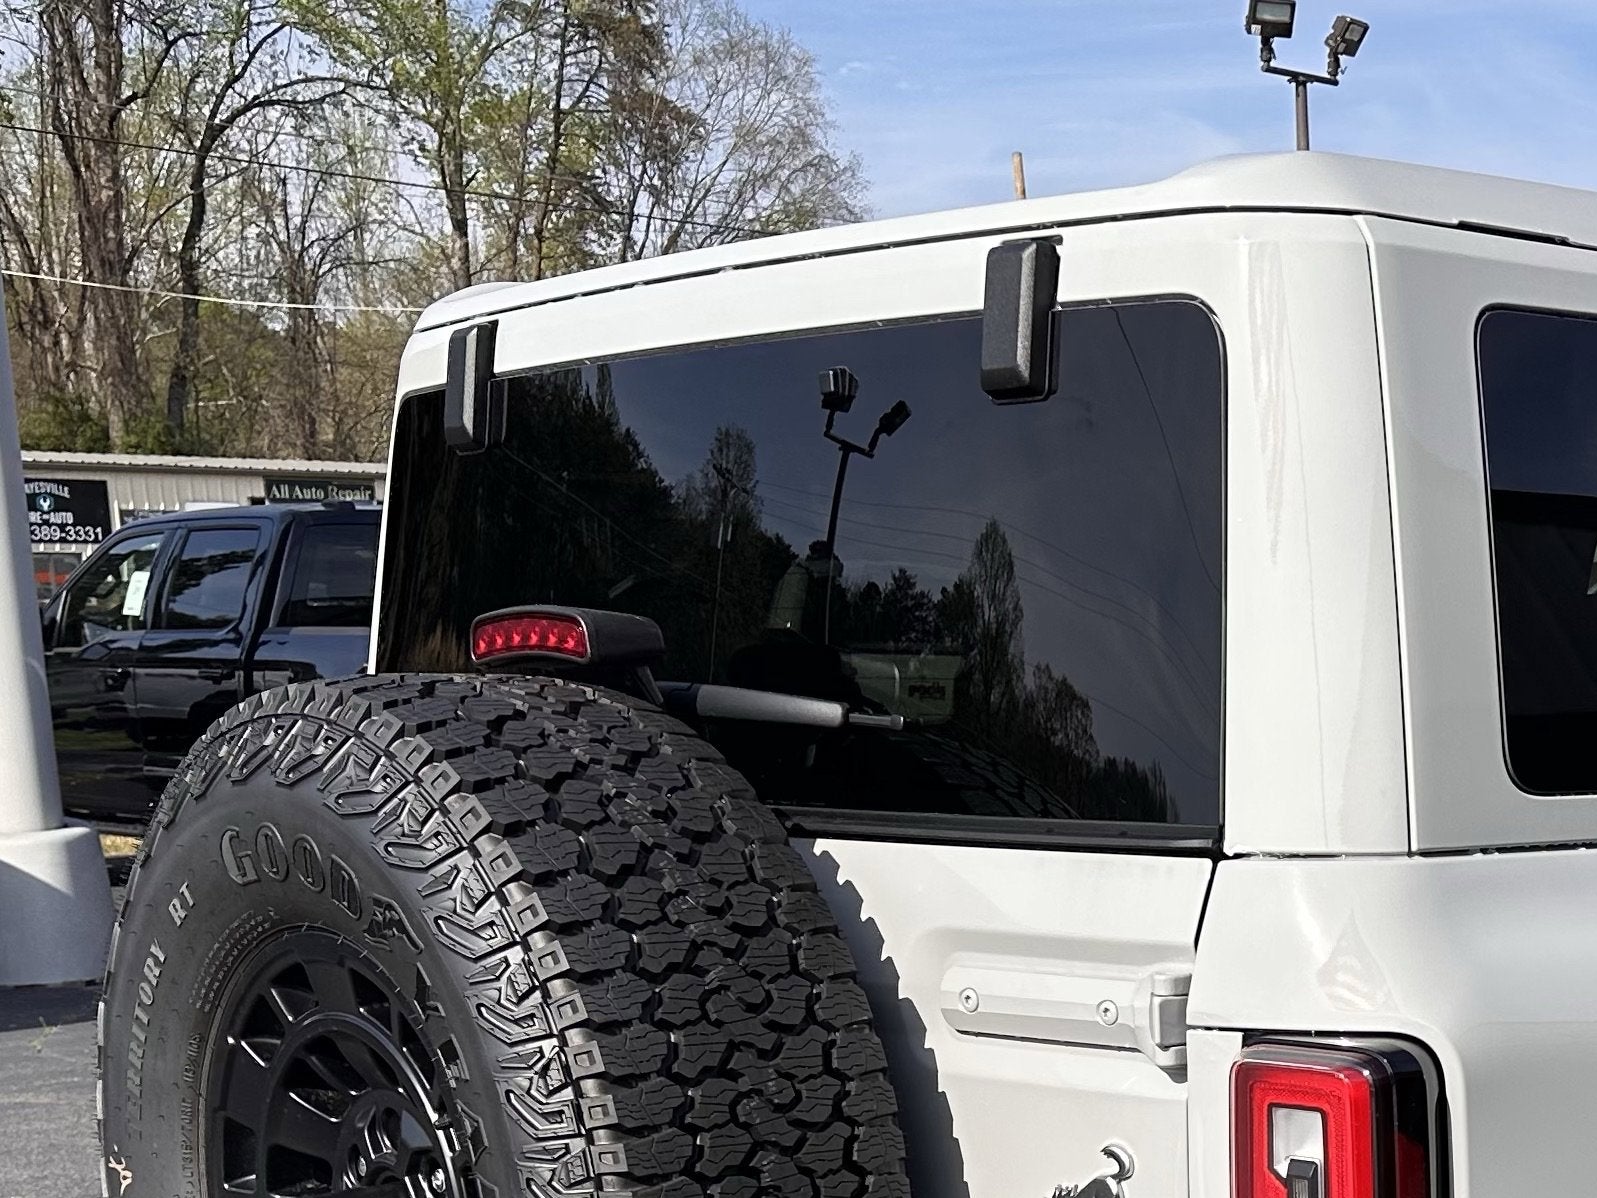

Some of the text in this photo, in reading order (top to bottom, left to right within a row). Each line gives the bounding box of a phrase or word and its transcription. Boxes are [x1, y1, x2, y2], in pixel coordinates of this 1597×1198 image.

[269, 484, 372, 501] All Auto Repair
[30, 525, 103, 541] 389-3331
[219, 820, 363, 921] GOOD
[168, 880, 196, 927] RT
